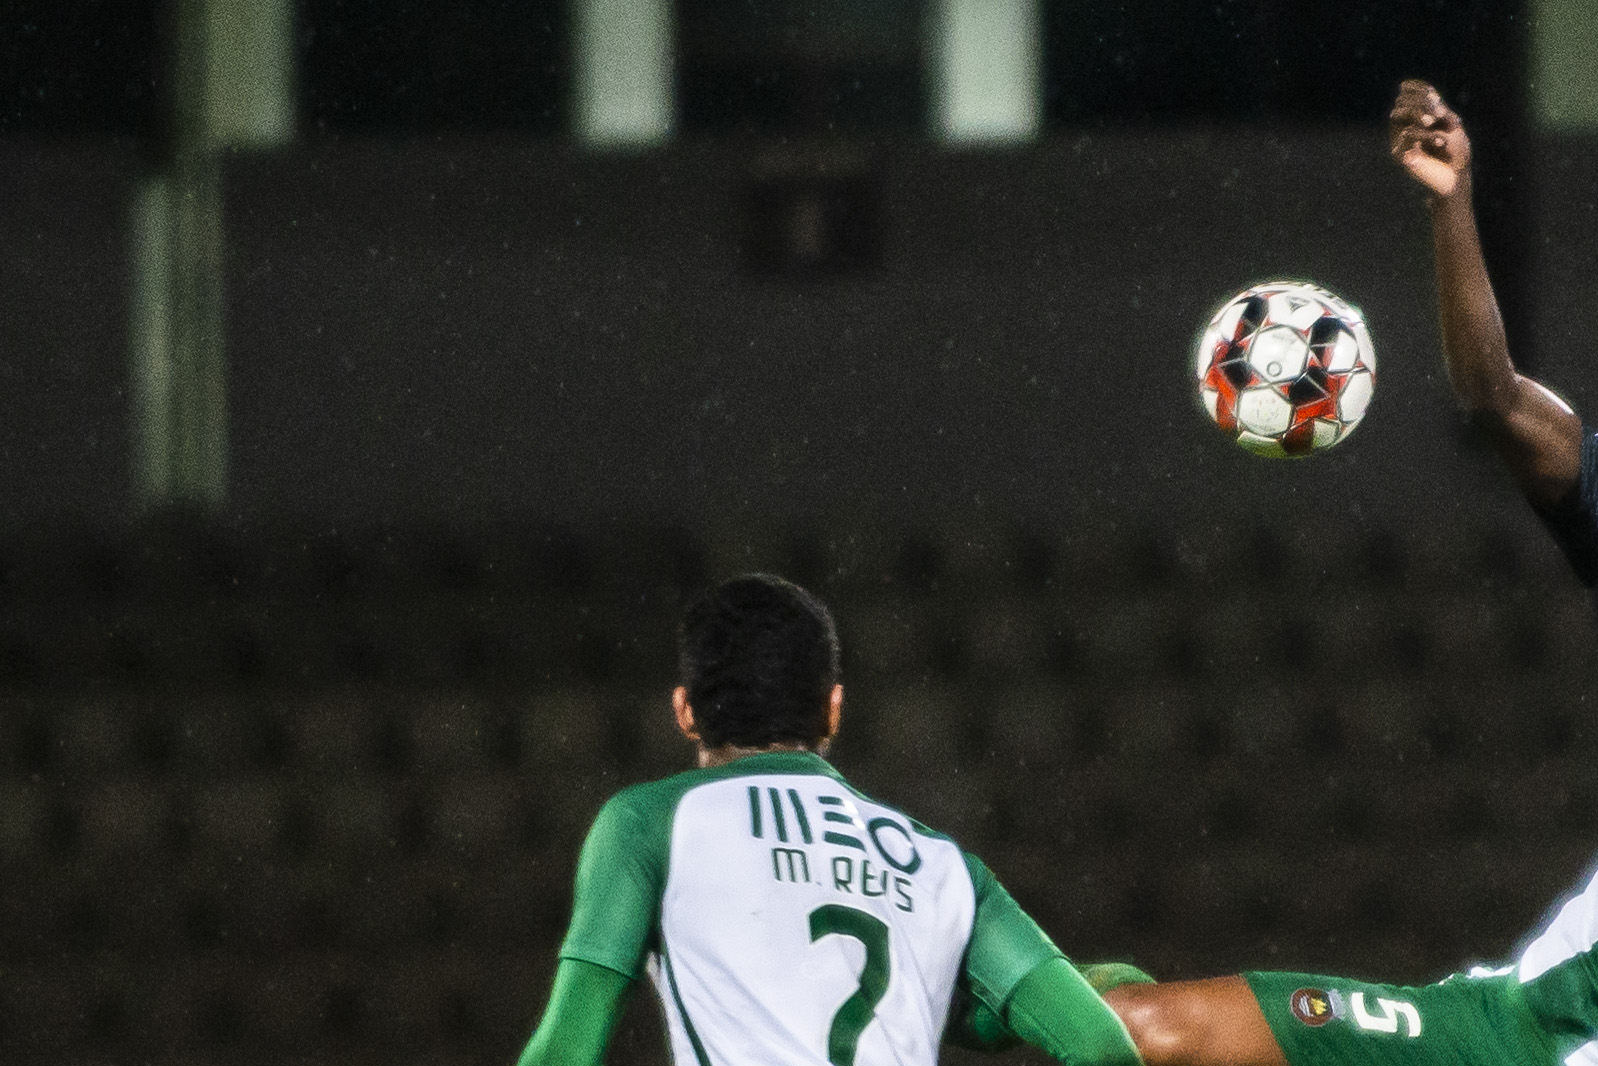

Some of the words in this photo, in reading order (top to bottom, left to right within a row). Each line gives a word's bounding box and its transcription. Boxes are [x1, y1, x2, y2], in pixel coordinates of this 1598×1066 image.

[747, 785, 923, 875] MEO
[832, 855, 914, 913] REIS
[1351, 992, 1421, 1038] 5
